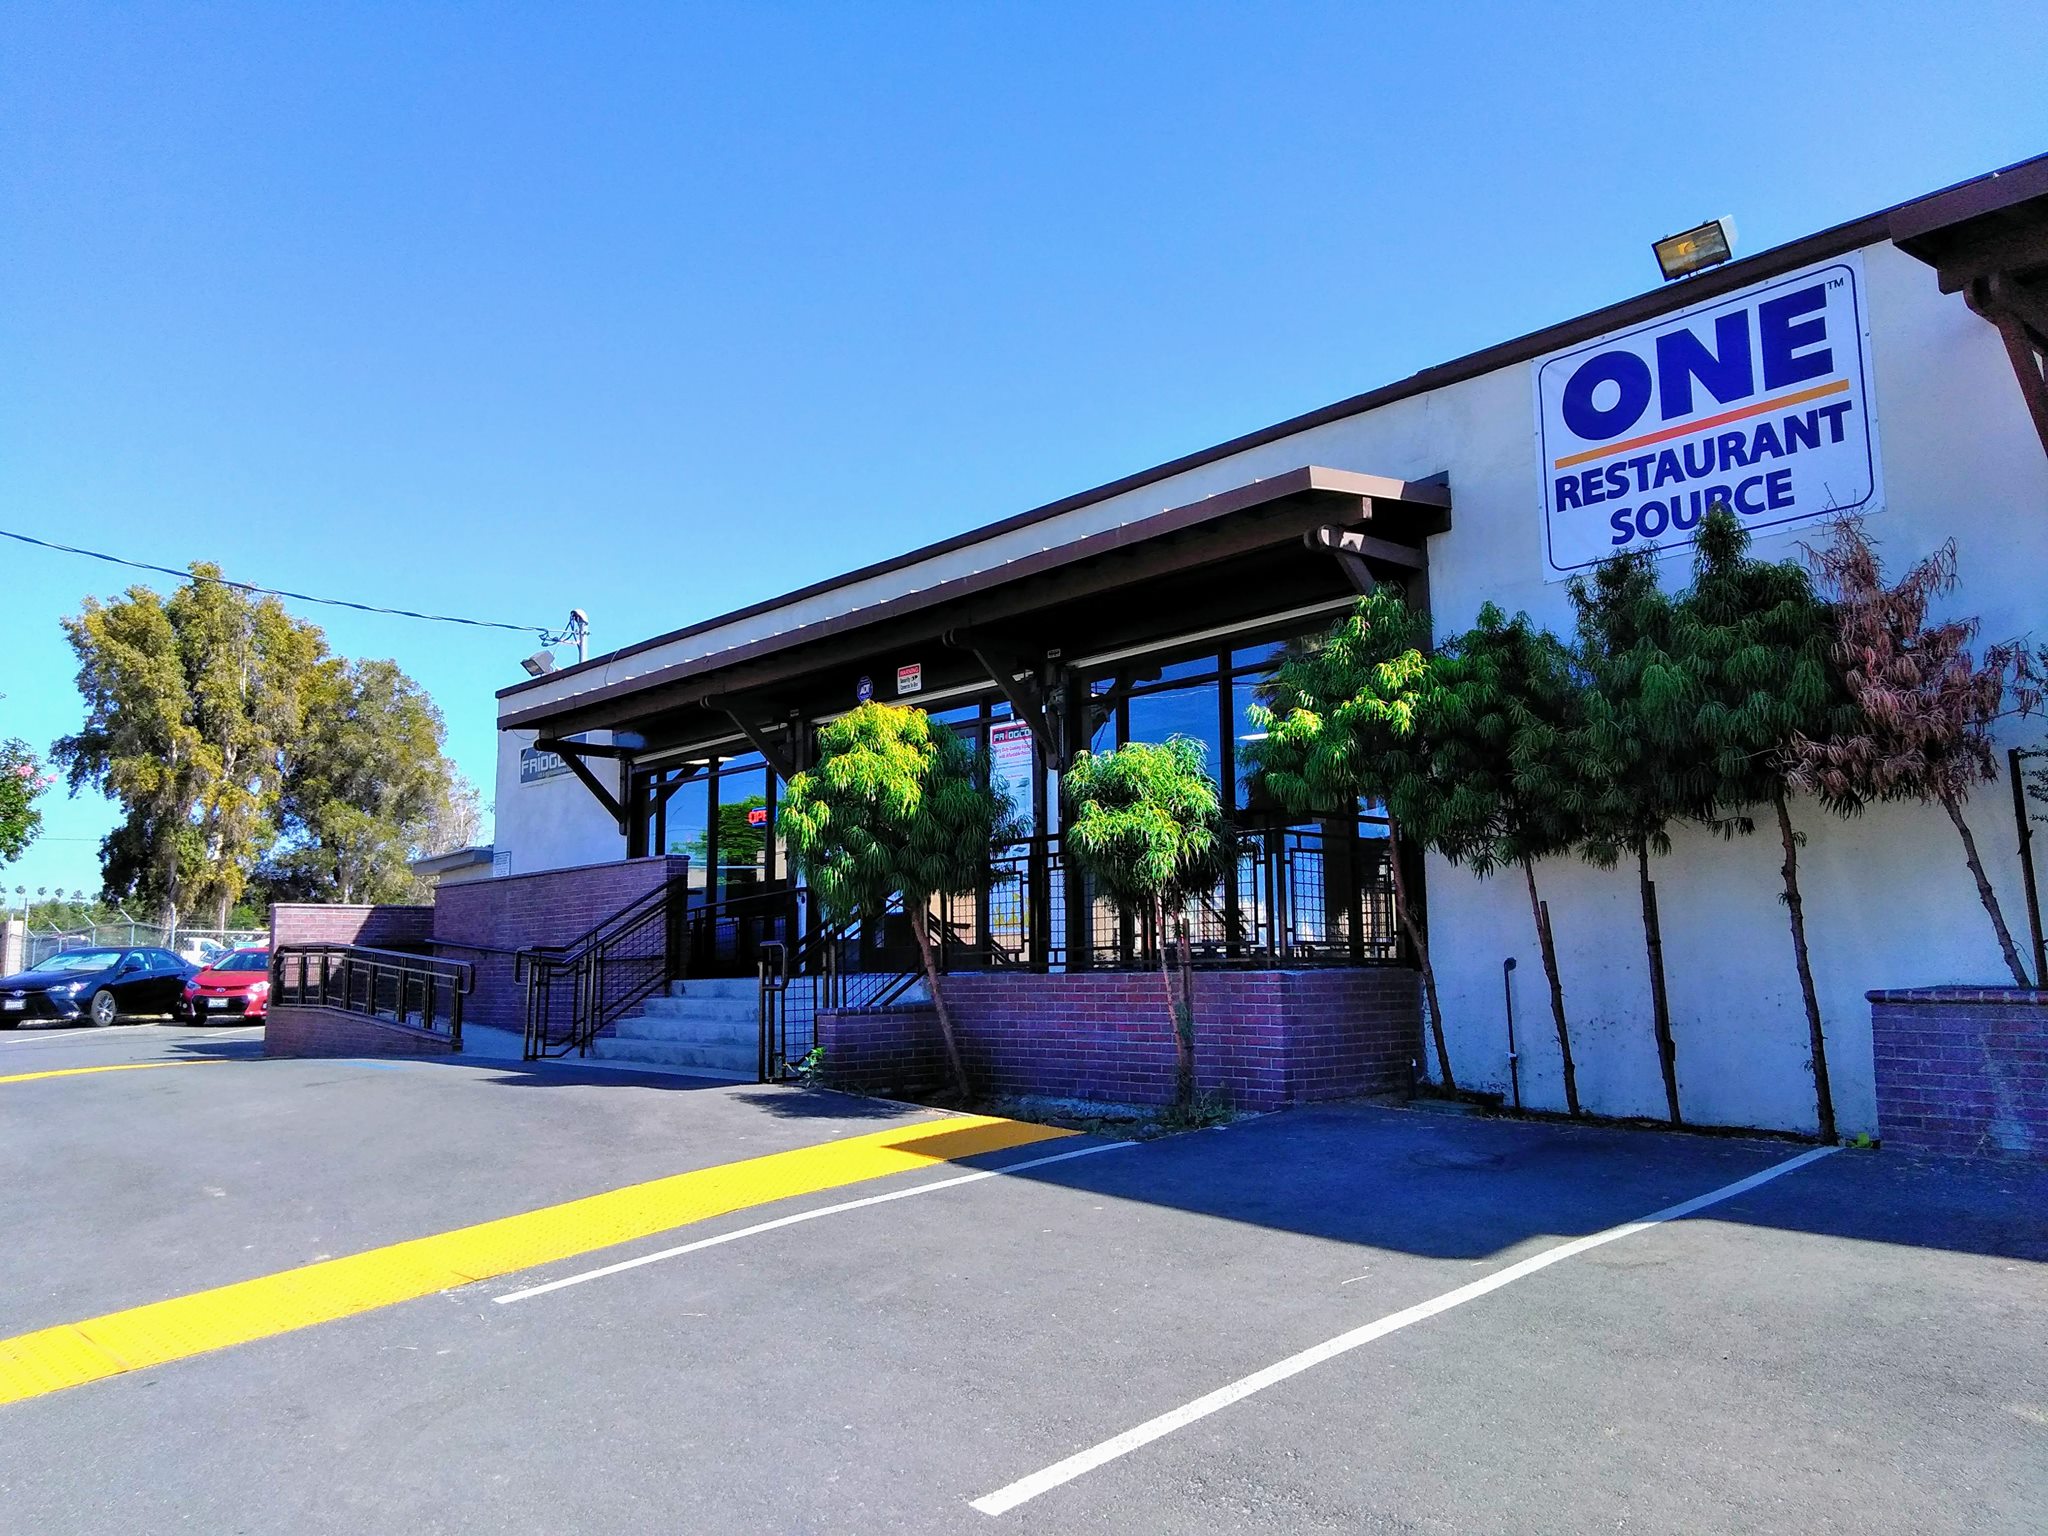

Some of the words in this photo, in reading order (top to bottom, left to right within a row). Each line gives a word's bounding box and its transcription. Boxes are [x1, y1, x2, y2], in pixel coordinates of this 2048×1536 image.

[1562, 282, 1834, 441] ONE
[1826, 277, 1844, 290] TM
[1554, 400, 1852, 513] RESTAURANT
[1610, 467, 1796, 545] SOURCE
[749, 810, 768, 824] OPE
